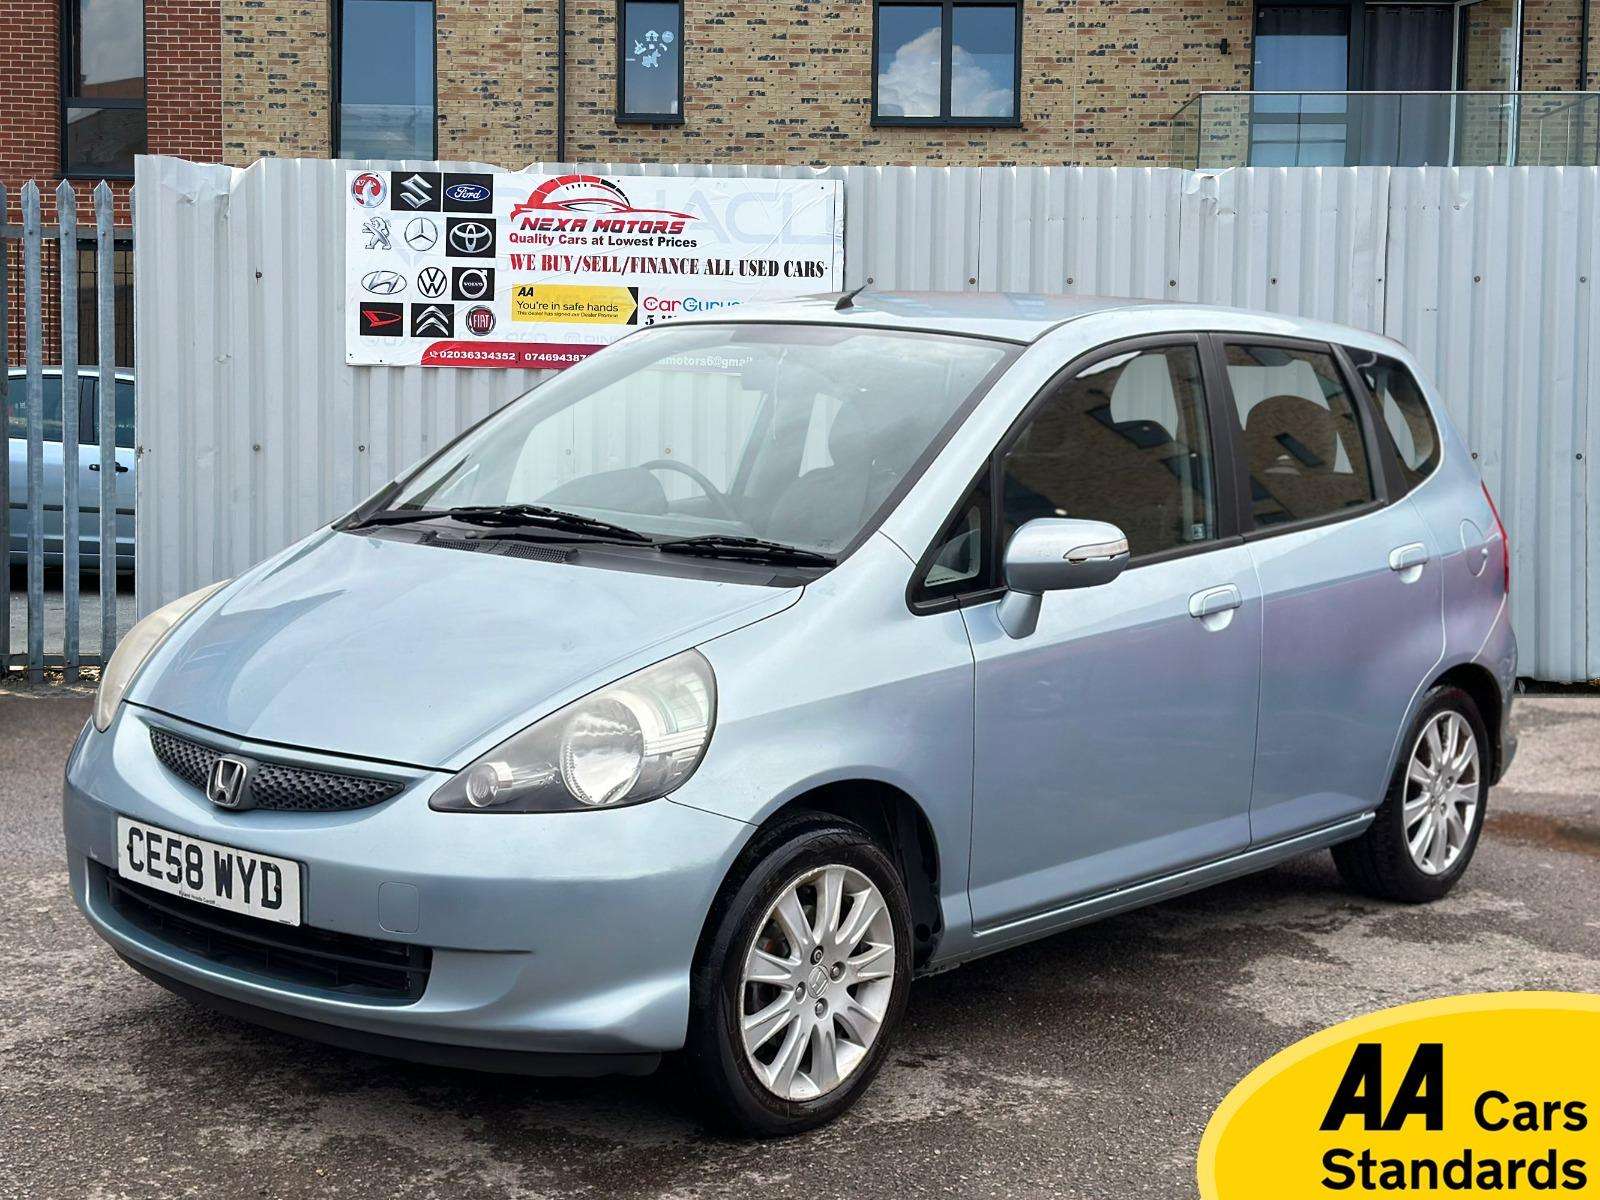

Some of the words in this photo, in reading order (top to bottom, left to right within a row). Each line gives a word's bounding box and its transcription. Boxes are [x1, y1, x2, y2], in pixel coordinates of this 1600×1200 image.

[454, 186, 481, 199] Ford
[520, 217, 588, 232] NEXA
[592, 219, 686, 235] MOTORS
[509, 232, 555, 246] Quality
[558, 234, 588, 246] Cars
[591, 236, 604, 246] at
[608, 236, 654, 247] Lowest
[657, 236, 697, 248] Prices
[509, 253, 536, 271] WE
[541, 254, 700, 276] BUY/SELL/FINANCE
[704, 258, 734, 276] ALL
[739, 259, 780, 277] USED
[783, 260, 825, 278] CARS
[518, 286, 534, 297] AA
[517, 300, 549, 310] You're
[551, 302, 560, 310] in
[563, 302, 585, 311] safe
[587, 303, 619, 312] hands
[643, 296, 743, 312] CarGur
[473, 314, 490, 328] FIAT
[129, 826, 204, 891] CE58
[213, 850, 282, 910] WYD
